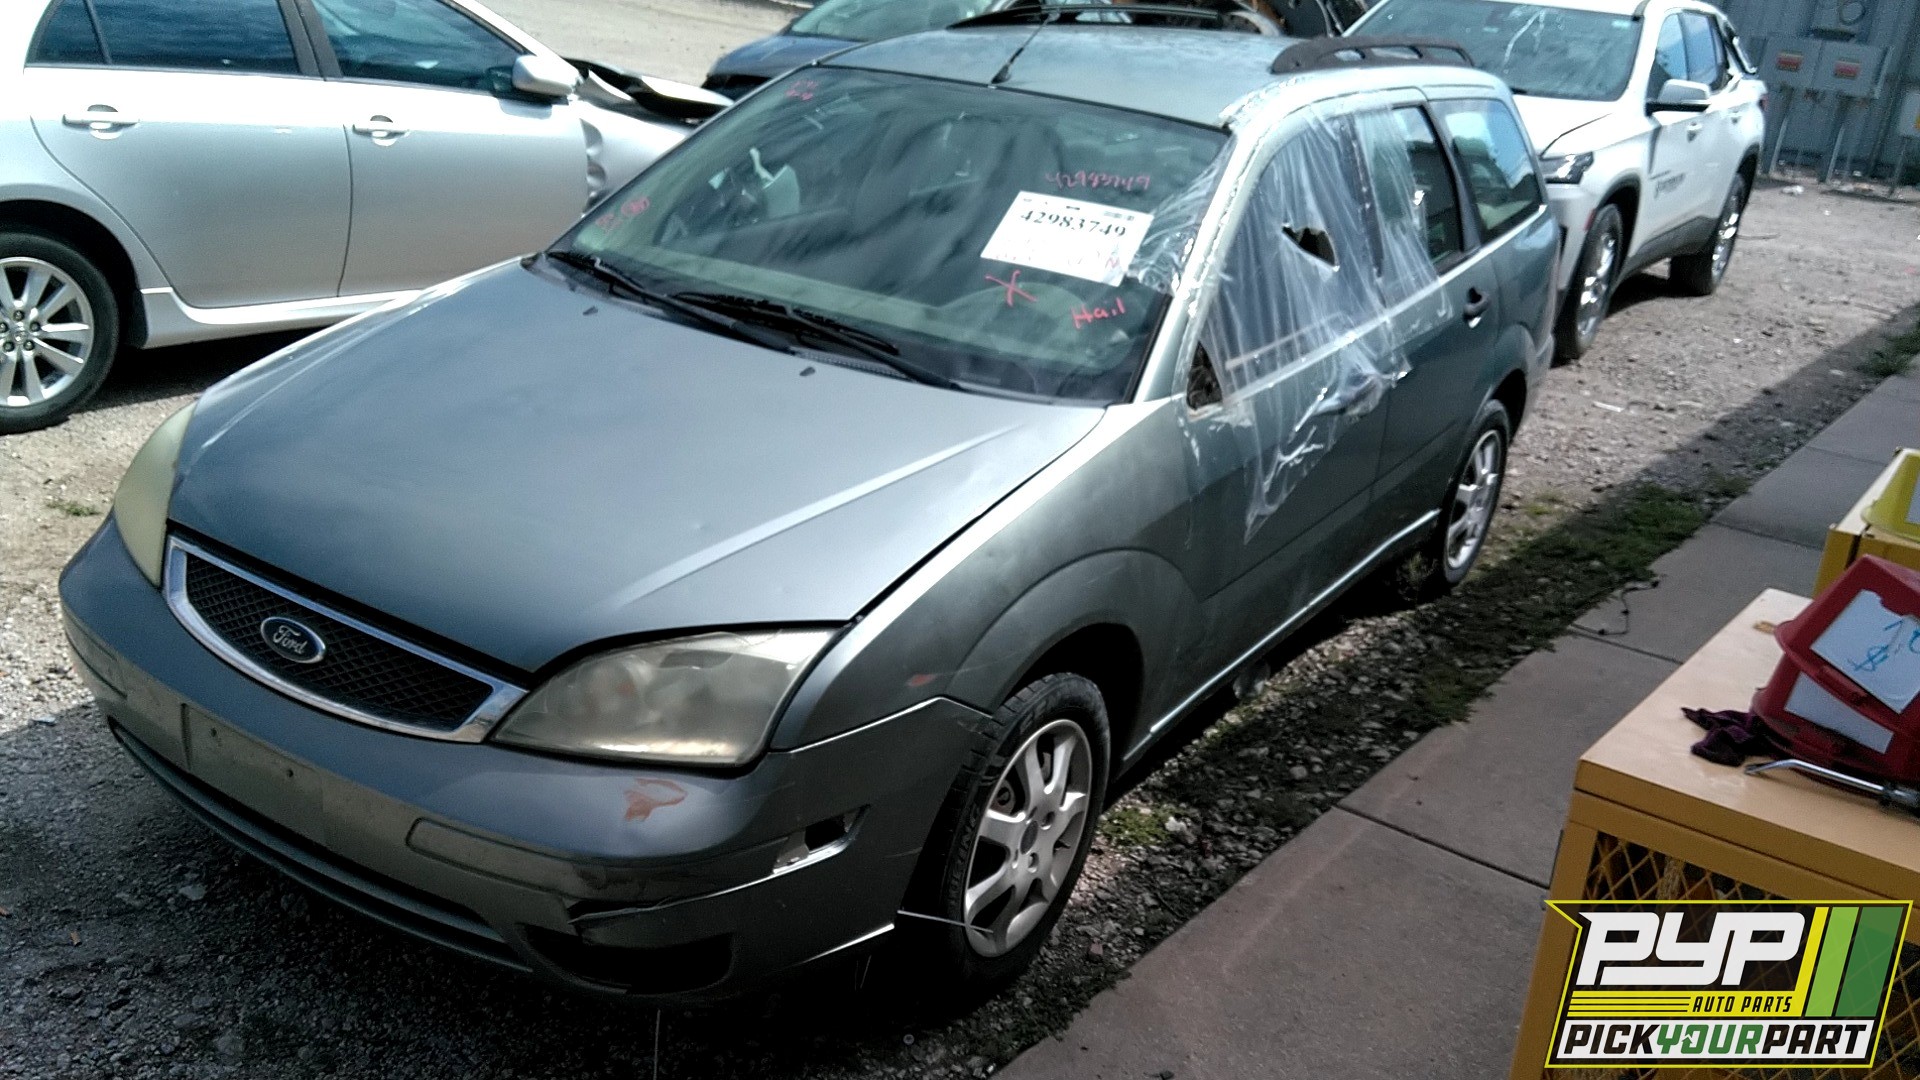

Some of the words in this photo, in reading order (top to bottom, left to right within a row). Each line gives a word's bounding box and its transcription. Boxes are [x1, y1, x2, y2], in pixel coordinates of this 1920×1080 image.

[1021, 210, 1126, 237] 42983749
[1071, 297, 1126, 329] Hail
[273, 625, 308, 655] Ford
